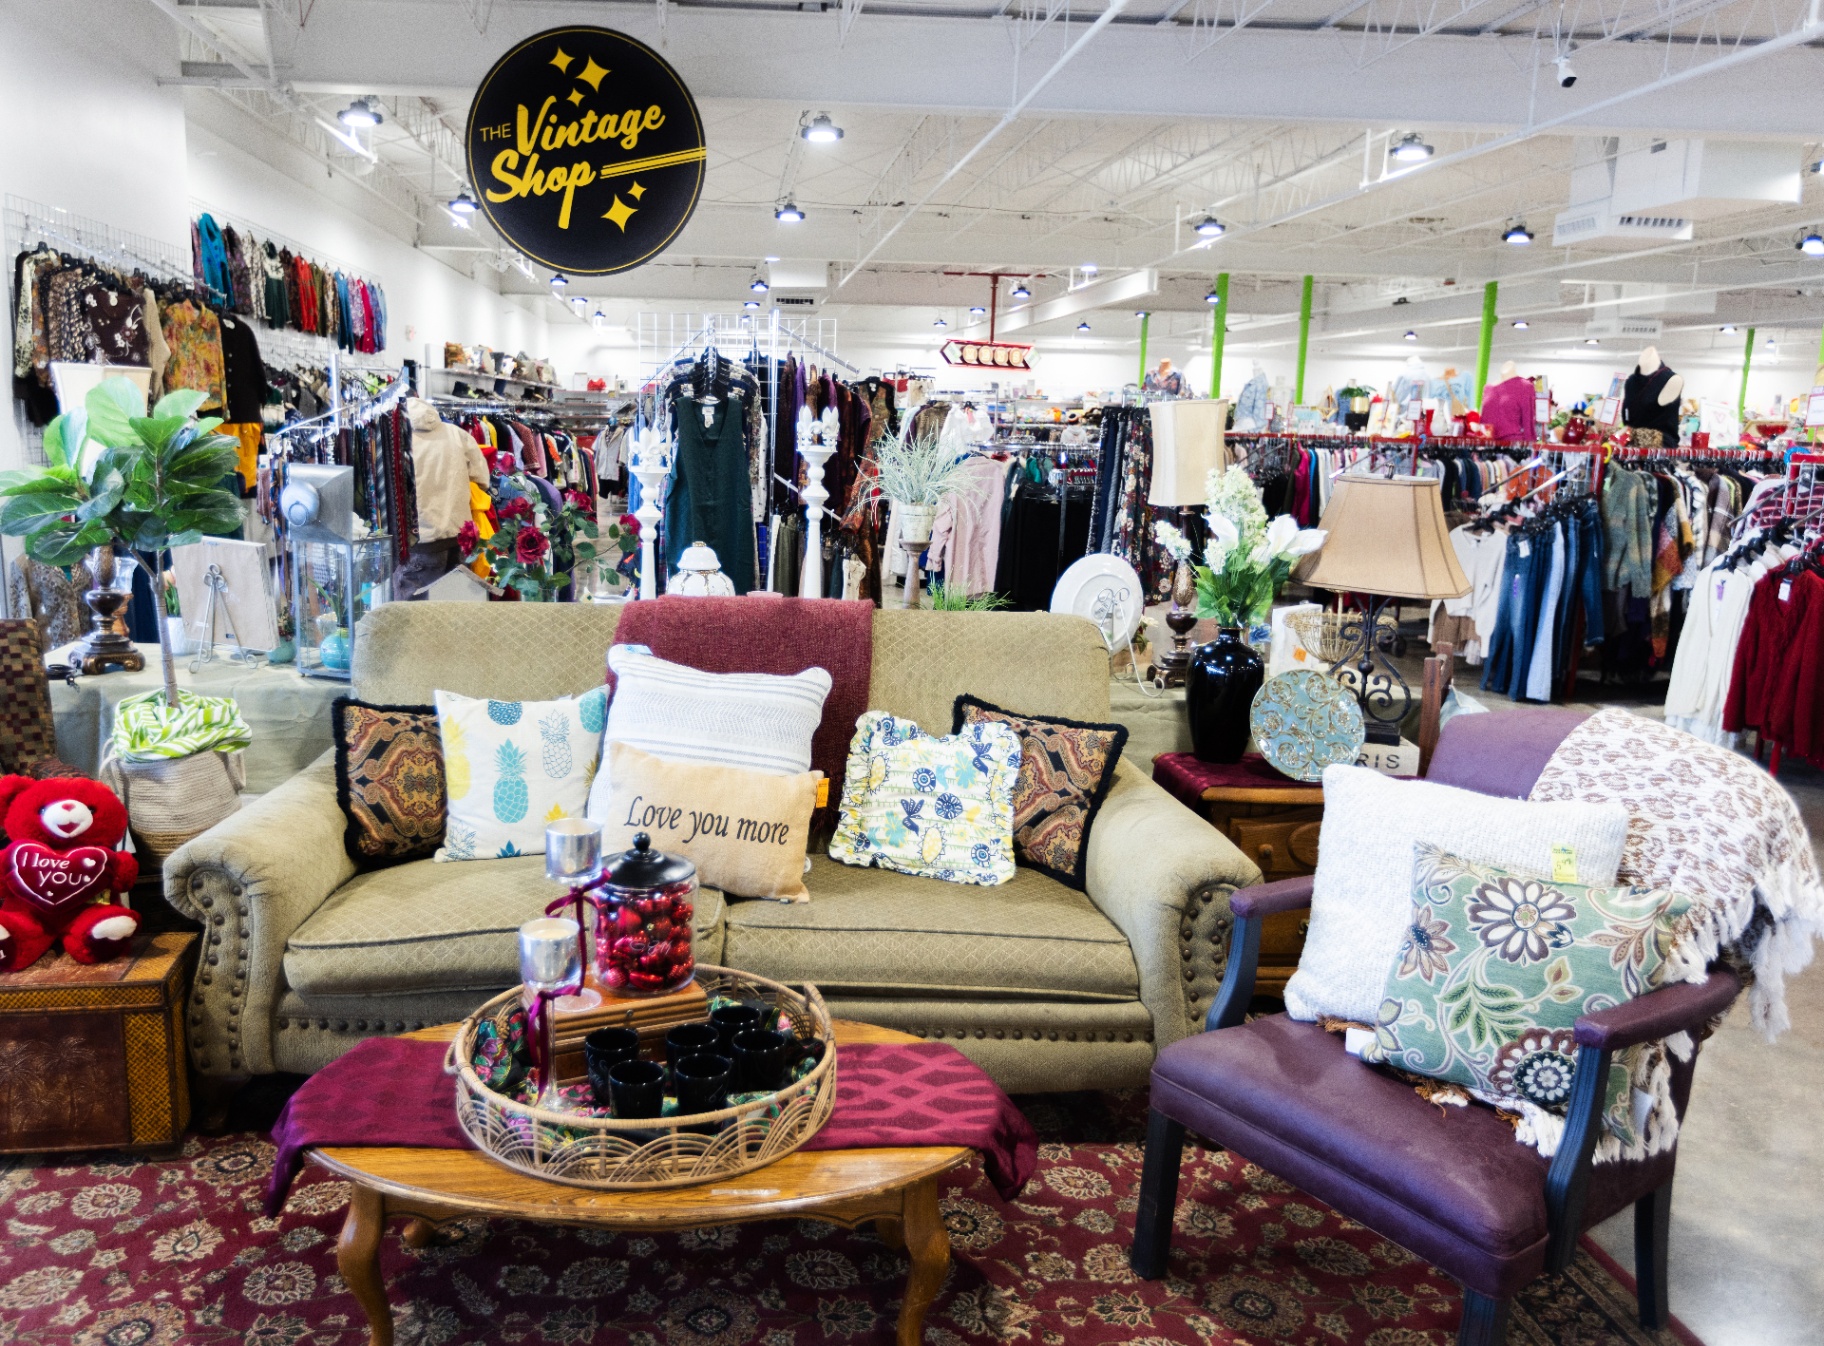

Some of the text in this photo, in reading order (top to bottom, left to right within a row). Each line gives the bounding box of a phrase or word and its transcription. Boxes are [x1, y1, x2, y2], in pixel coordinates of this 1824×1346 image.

[480, 95, 666, 157] THE Vintage
[485, 148, 597, 230] Shop
[623, 795, 790, 846] Love you more
[22, 851, 70, 870] I love
